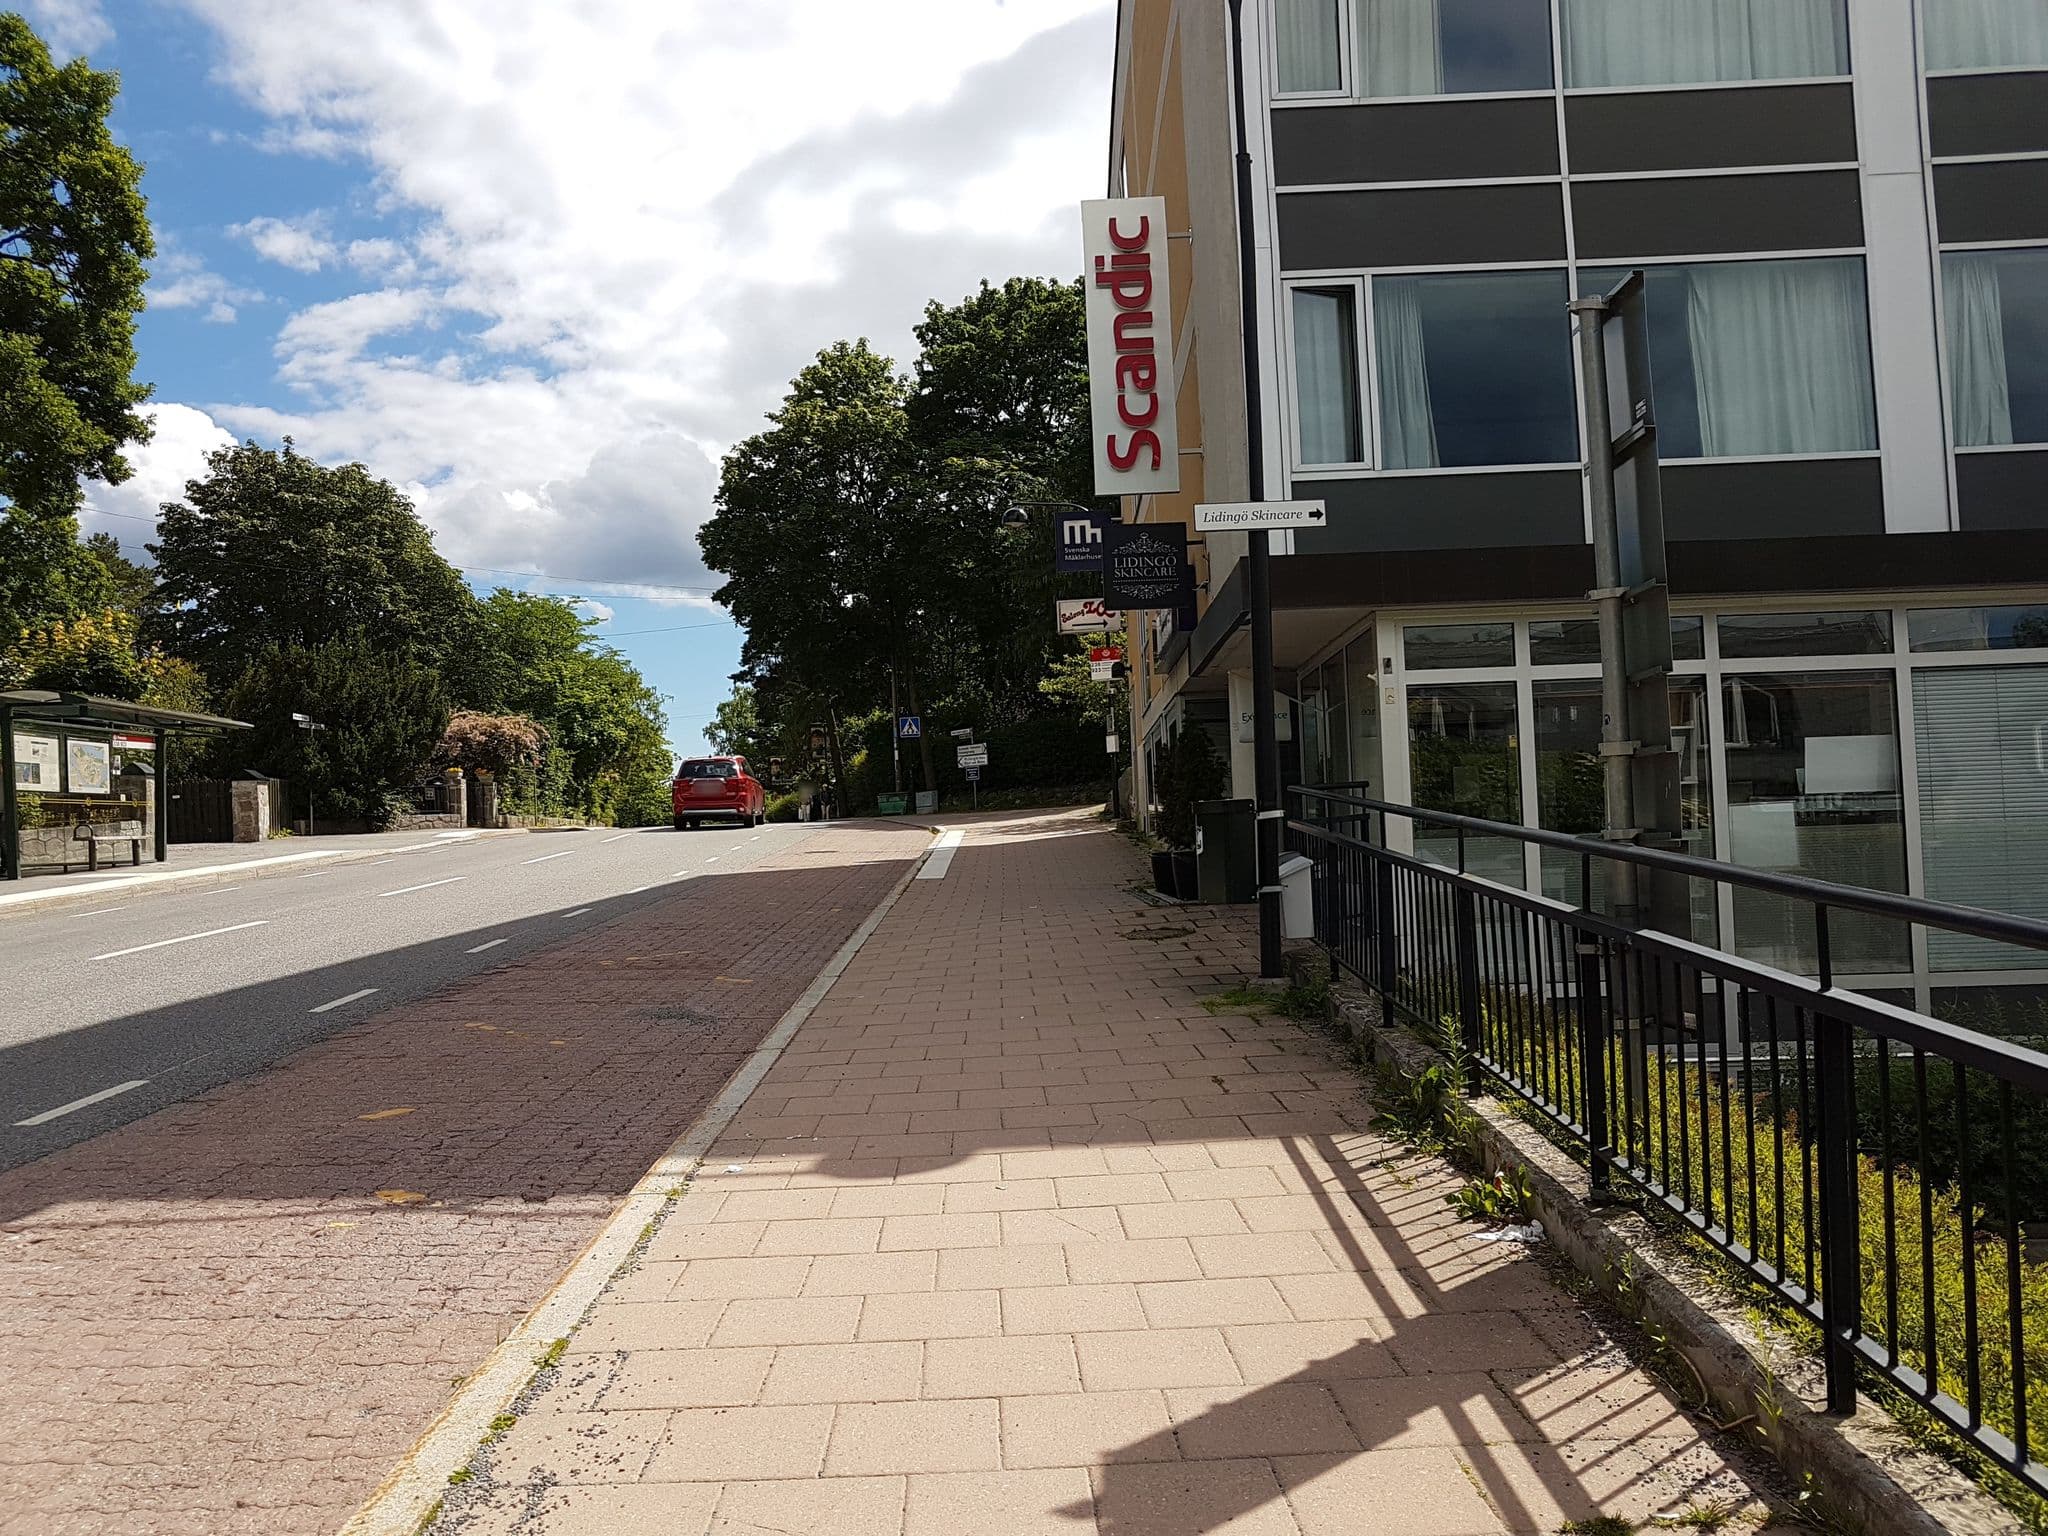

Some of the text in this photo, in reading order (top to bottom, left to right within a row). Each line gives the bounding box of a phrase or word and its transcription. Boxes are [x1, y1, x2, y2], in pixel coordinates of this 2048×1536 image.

[1094, 215, 1161, 472] Scandic
[1203, 509, 1303, 524] Lidingö Skincare
[1064, 553, 1103, 561] Mäklarhuse
[1113, 553, 1177, 568] LIDINGÖ
[1113, 567, 1177, 578] SKINCARE
